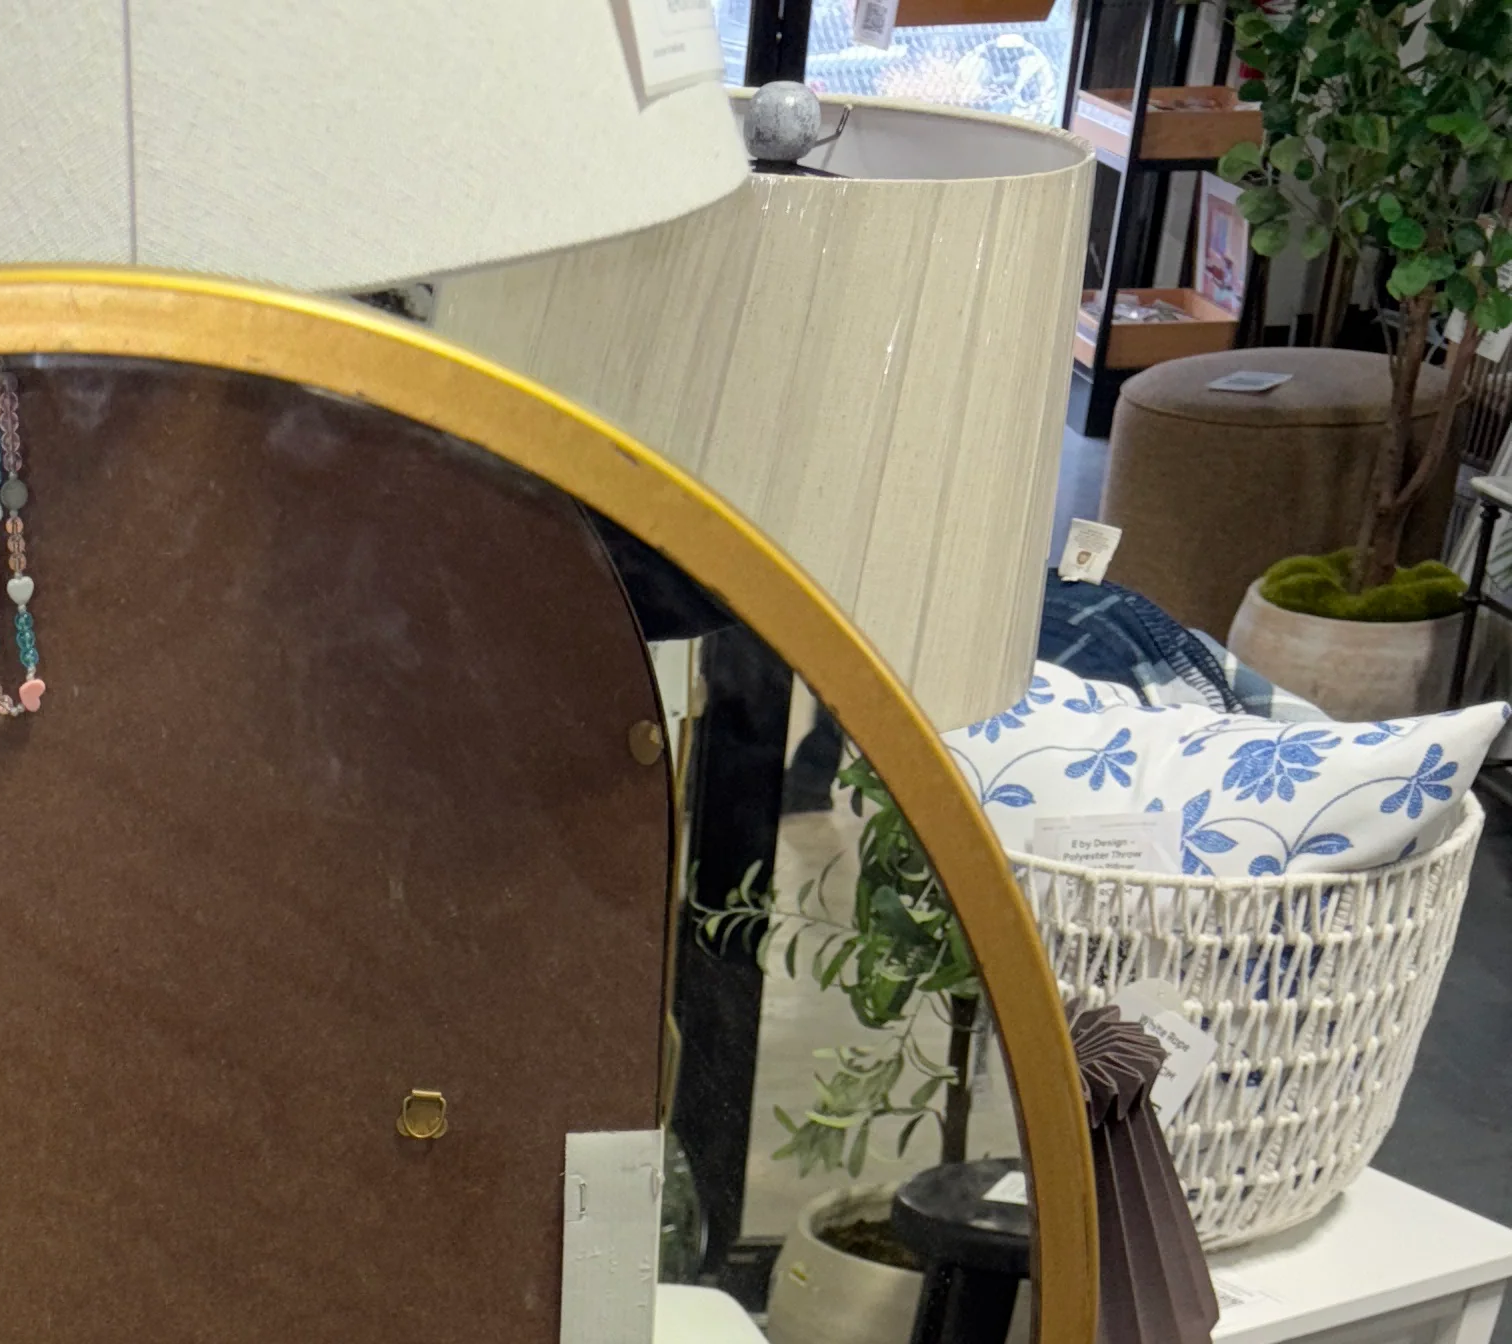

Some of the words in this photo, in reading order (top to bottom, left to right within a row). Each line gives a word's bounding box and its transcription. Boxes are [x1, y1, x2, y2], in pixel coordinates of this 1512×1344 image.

[1071, 839, 1077, 849] E
[1079, 839, 1092, 850] by
[1094, 838, 1128, 849] Design
[1062, 851, 1109, 862] Polyester
[1111, 850, 1143, 859] Throw
[1167, 1031, 1191, 1052] Rope
